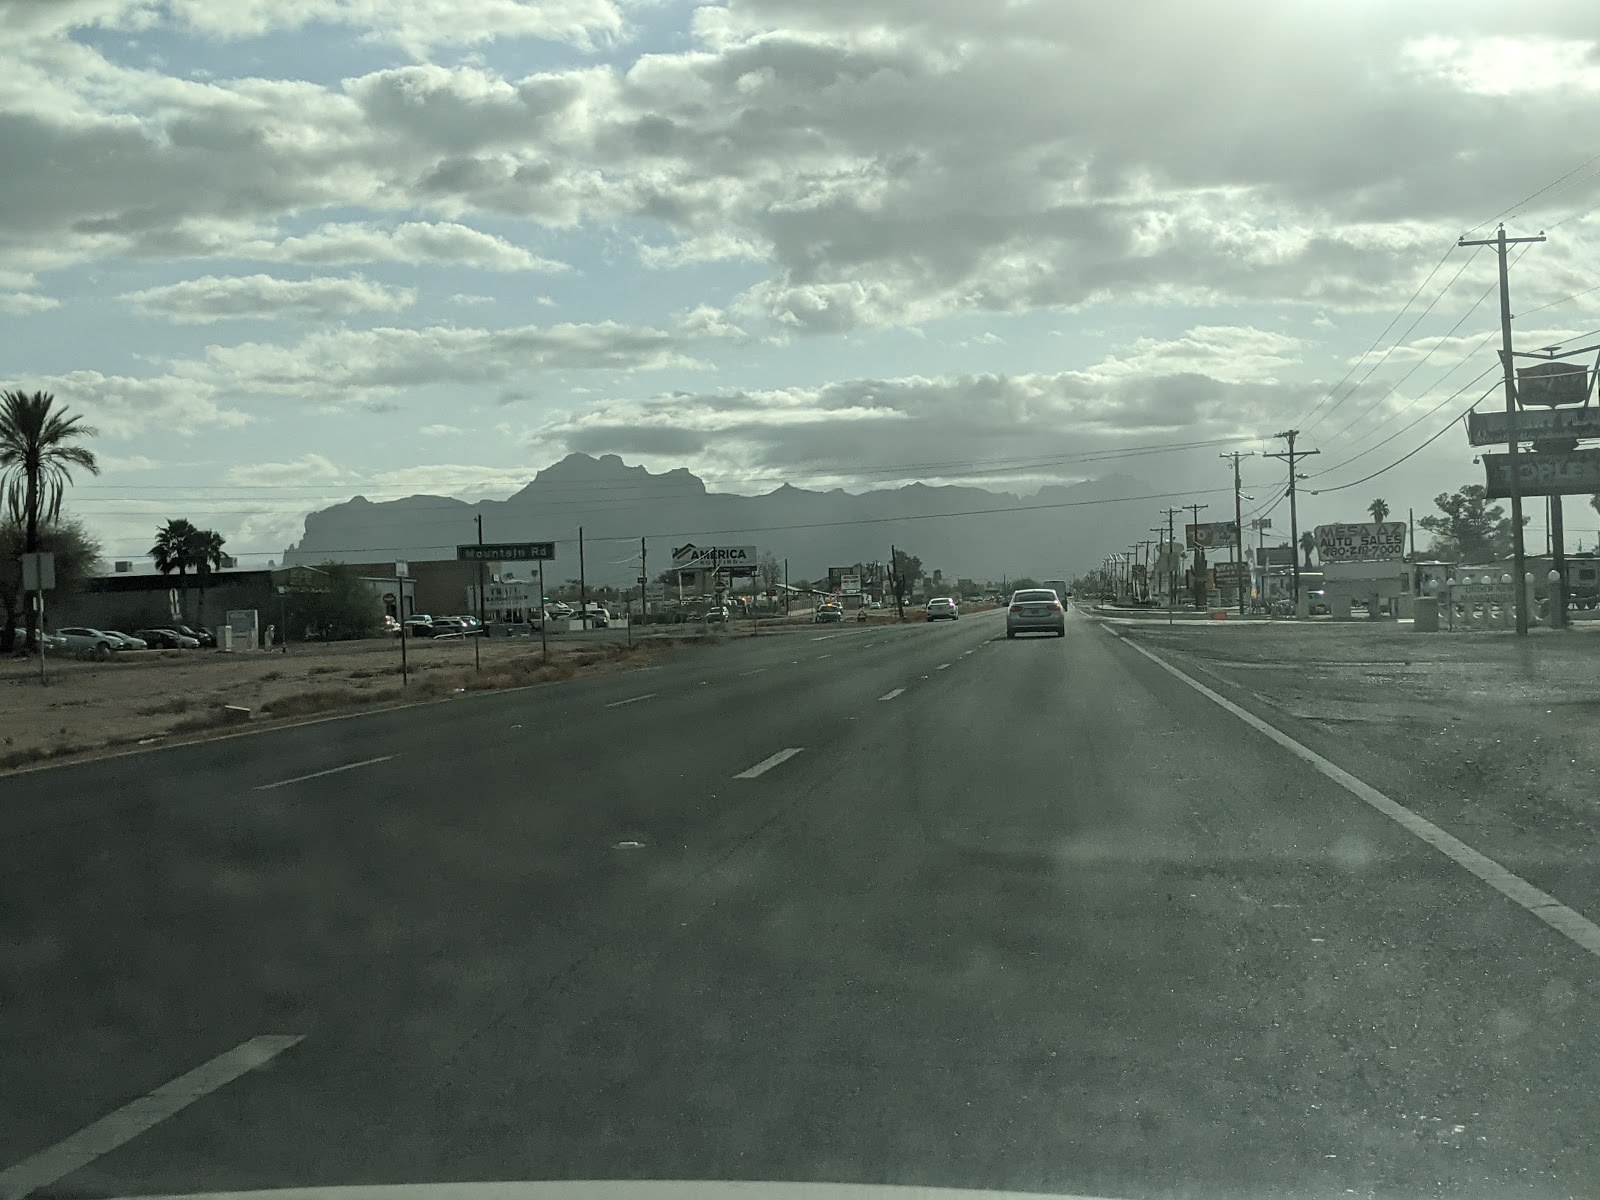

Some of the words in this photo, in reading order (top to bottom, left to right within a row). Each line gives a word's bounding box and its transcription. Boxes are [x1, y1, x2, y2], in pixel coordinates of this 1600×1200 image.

[1321, 525, 1370, 538] MESA
[1377, 523, 1401, 536] AZ
[1320, 537, 1352, 548] AUTO
[1361, 534, 1402, 546] SALES
[465, 547, 525, 559] Mountain
[531, 546, 547, 557] Rd
[691, 549, 746, 560] AMERICA
